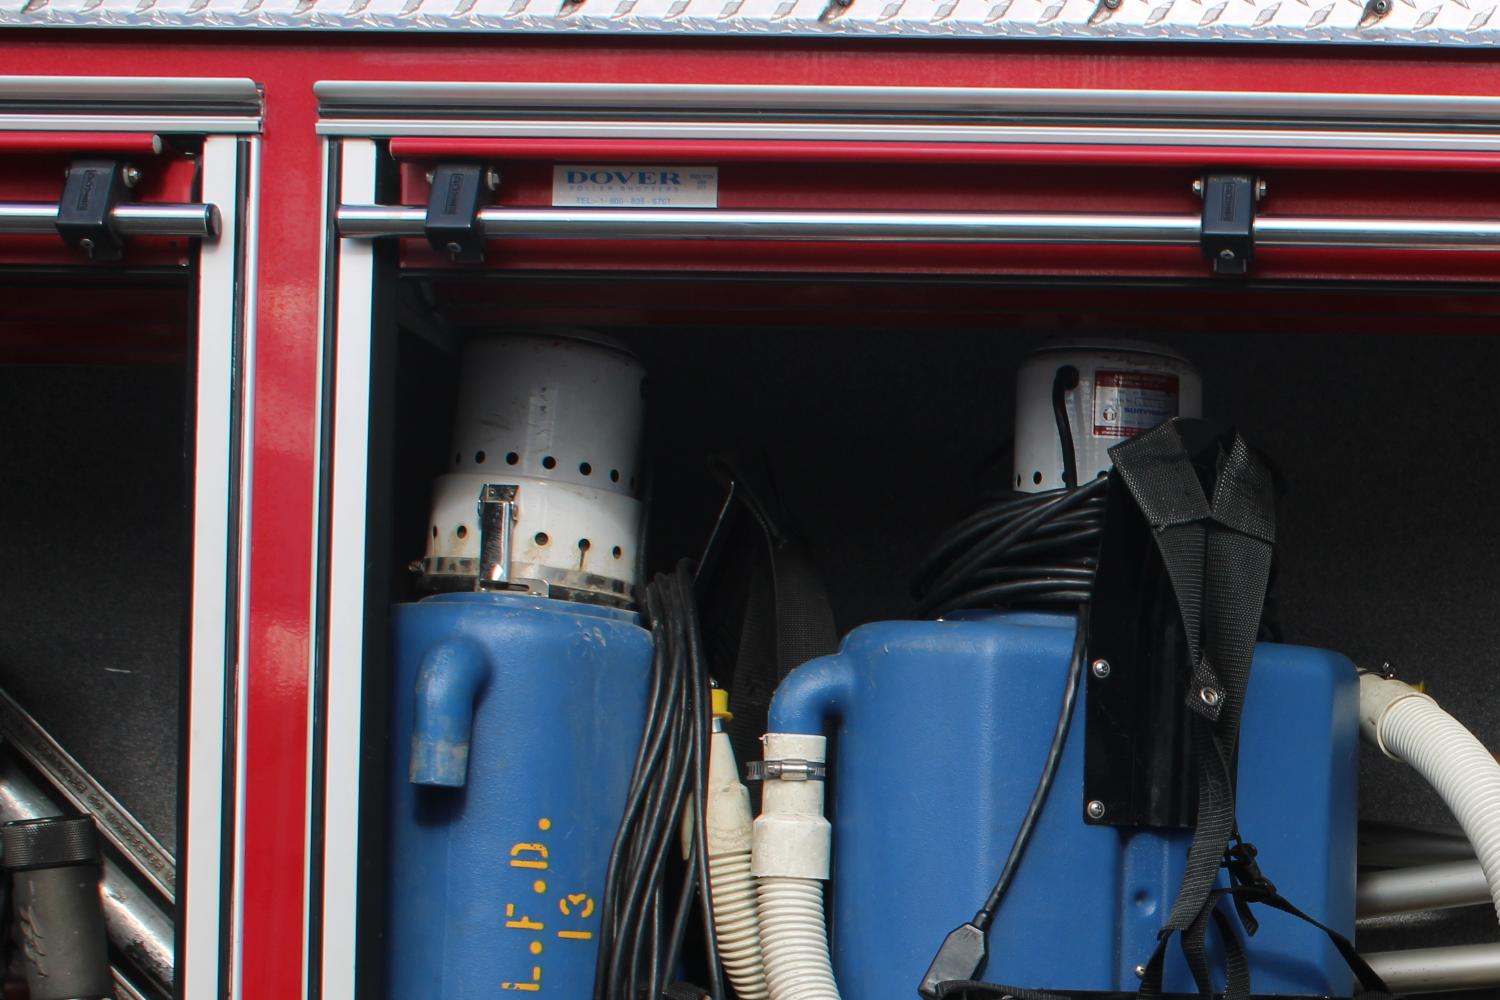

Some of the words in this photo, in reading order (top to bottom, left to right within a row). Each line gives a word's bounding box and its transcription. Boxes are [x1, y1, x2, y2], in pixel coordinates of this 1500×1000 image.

[567, 171, 681, 185] DOVER
[502, 818, 551, 991] L.F.D.
[557, 893, 594, 939] 13
